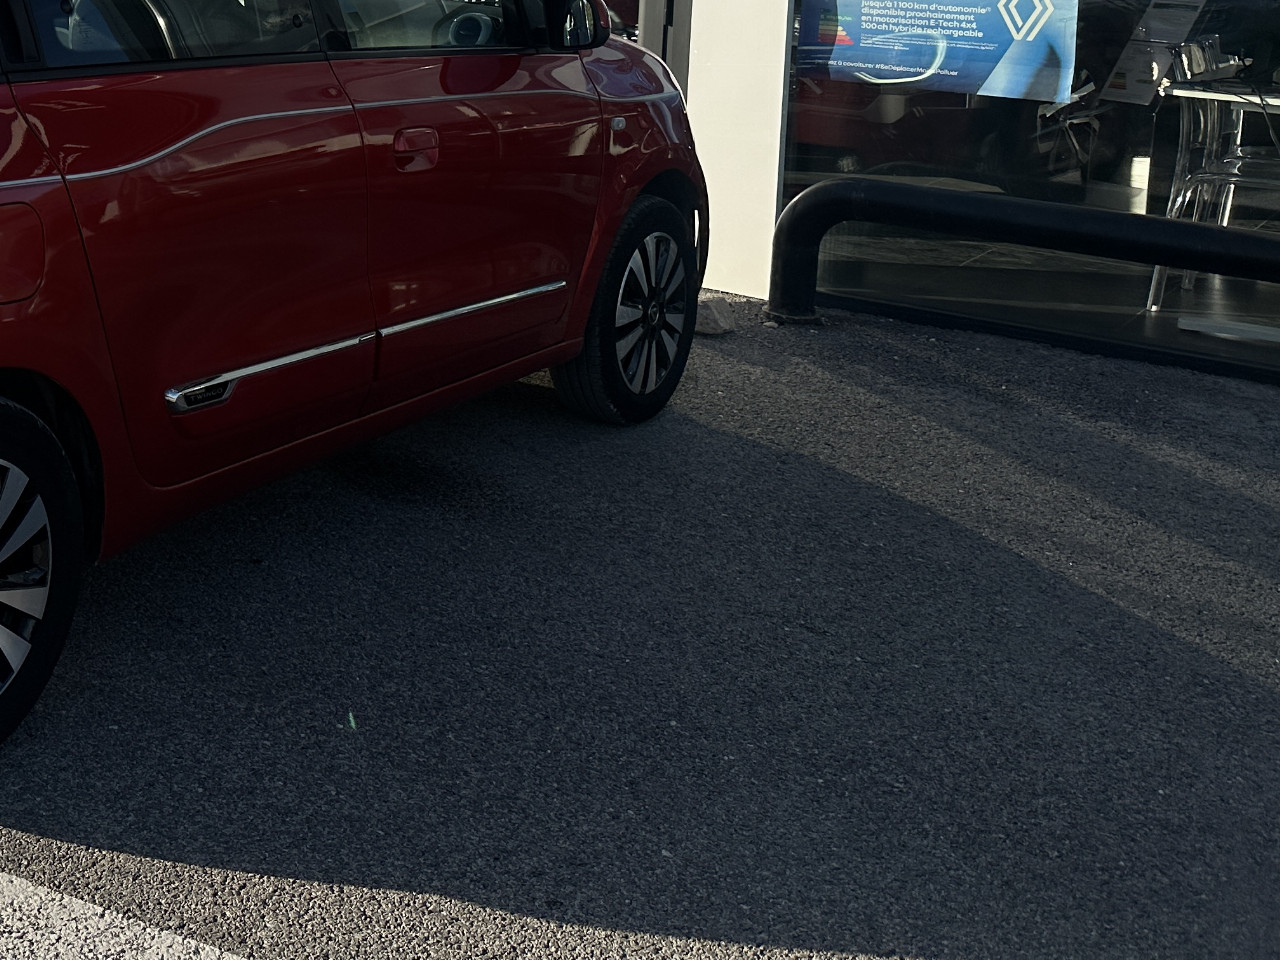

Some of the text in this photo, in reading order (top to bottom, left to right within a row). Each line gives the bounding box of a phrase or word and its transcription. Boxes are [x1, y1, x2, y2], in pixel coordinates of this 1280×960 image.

[914, 2, 928, 10] km
[861, 7, 905, 17] disponible
[906, 9, 975, 22] prochainement
[873, 16, 928, 26] motorisation
[930, 20, 960, 28] E-Tech
[960, 22, 977, 30] 4x4
[889, 24, 922, 33] hybride
[923, 27, 984, 38] rechargeable
